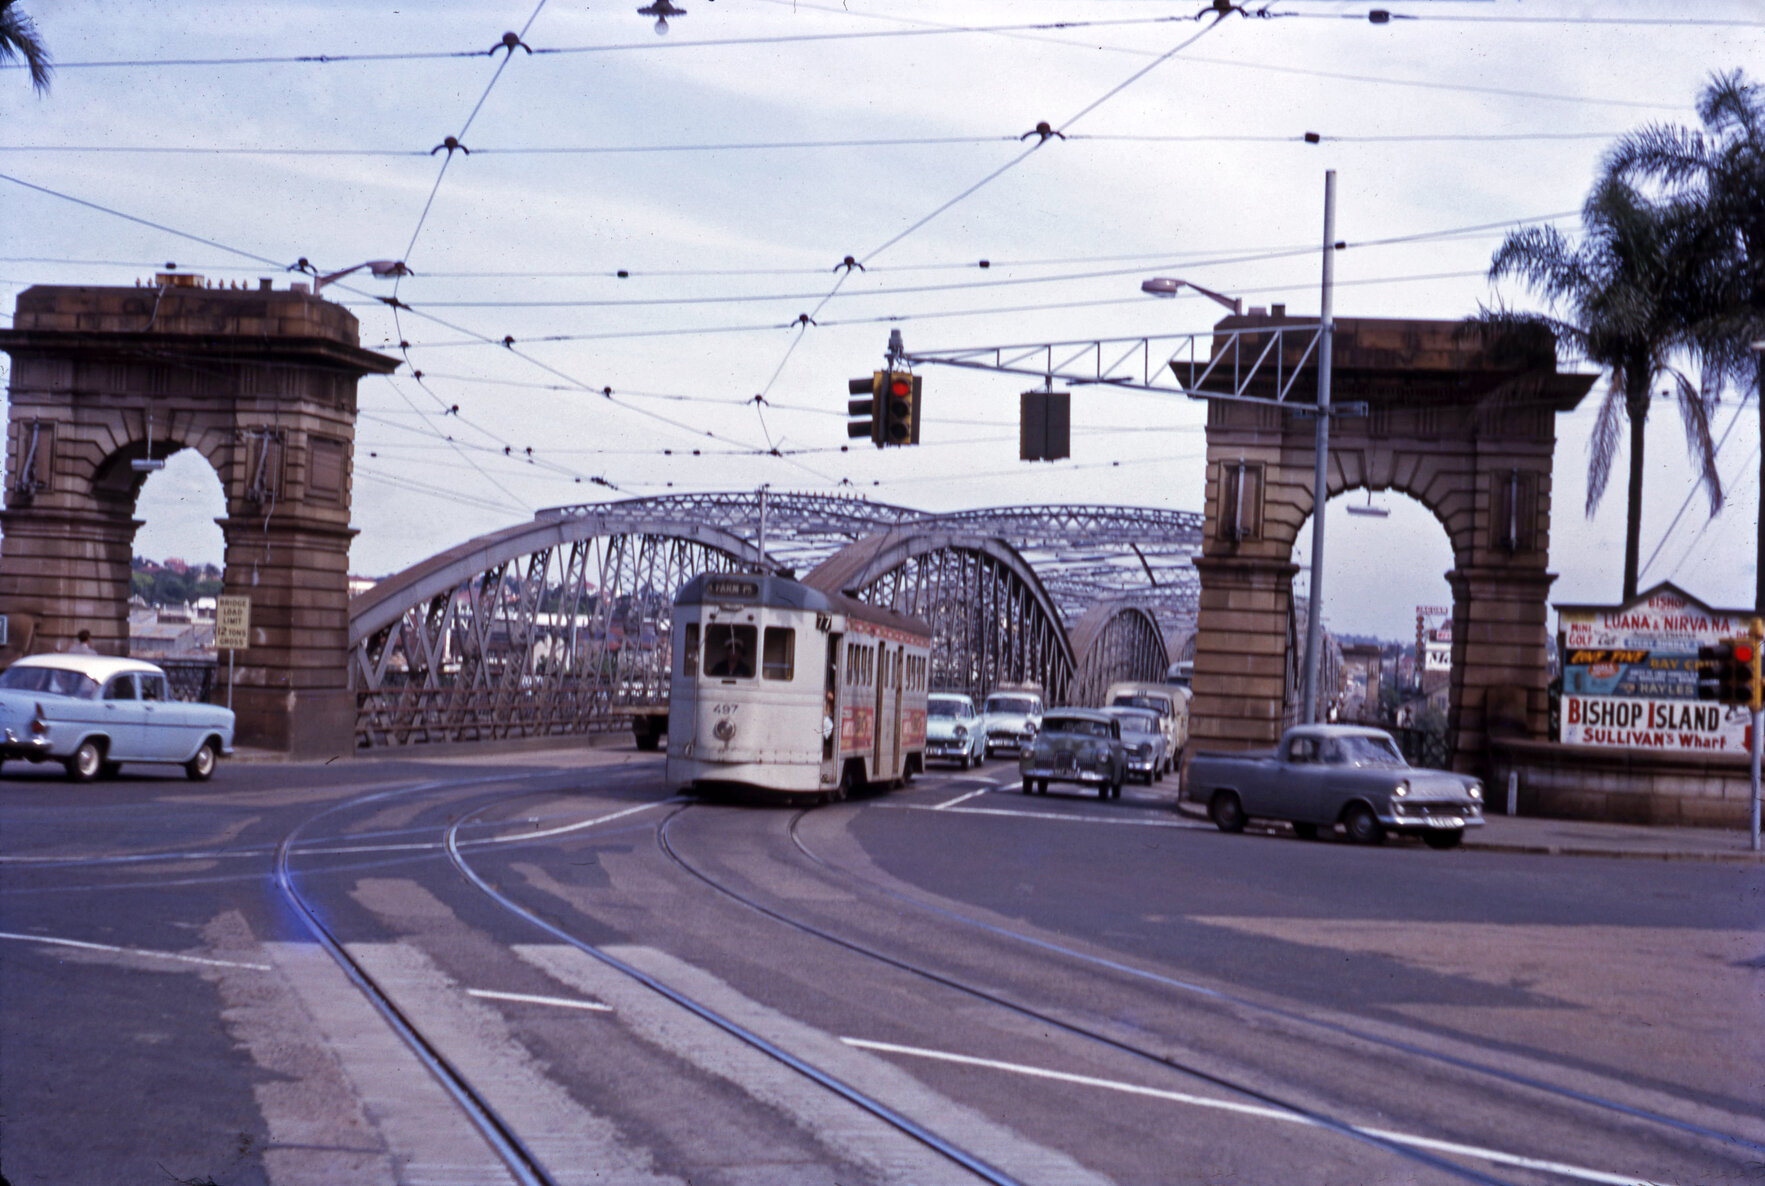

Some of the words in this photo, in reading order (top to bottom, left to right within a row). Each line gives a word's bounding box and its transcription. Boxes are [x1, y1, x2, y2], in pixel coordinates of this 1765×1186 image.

[220, 599, 247, 608] BRIDGE
[1648, 598, 1686, 609] BISHOP
[223, 608, 243, 616] LOAD
[223, 617, 242, 625] LIMIT
[1571, 624, 1592, 632] MINI
[229, 629, 247, 638] TONS
[219, 638, 244, 646] GROSS
[1569, 634, 1593, 645] GOLF
[1650, 658, 1679, 669] BAY
[1639, 682, 1694, 696] HAYLES
[713, 704, 738, 714] 497
[1568, 698, 1642, 727] BISHOP
[1648, 702, 1720, 732] ISLAND
[1583, 728, 1674, 747] SULLIVAN'S
[1679, 733, 1727, 749] Wharf
